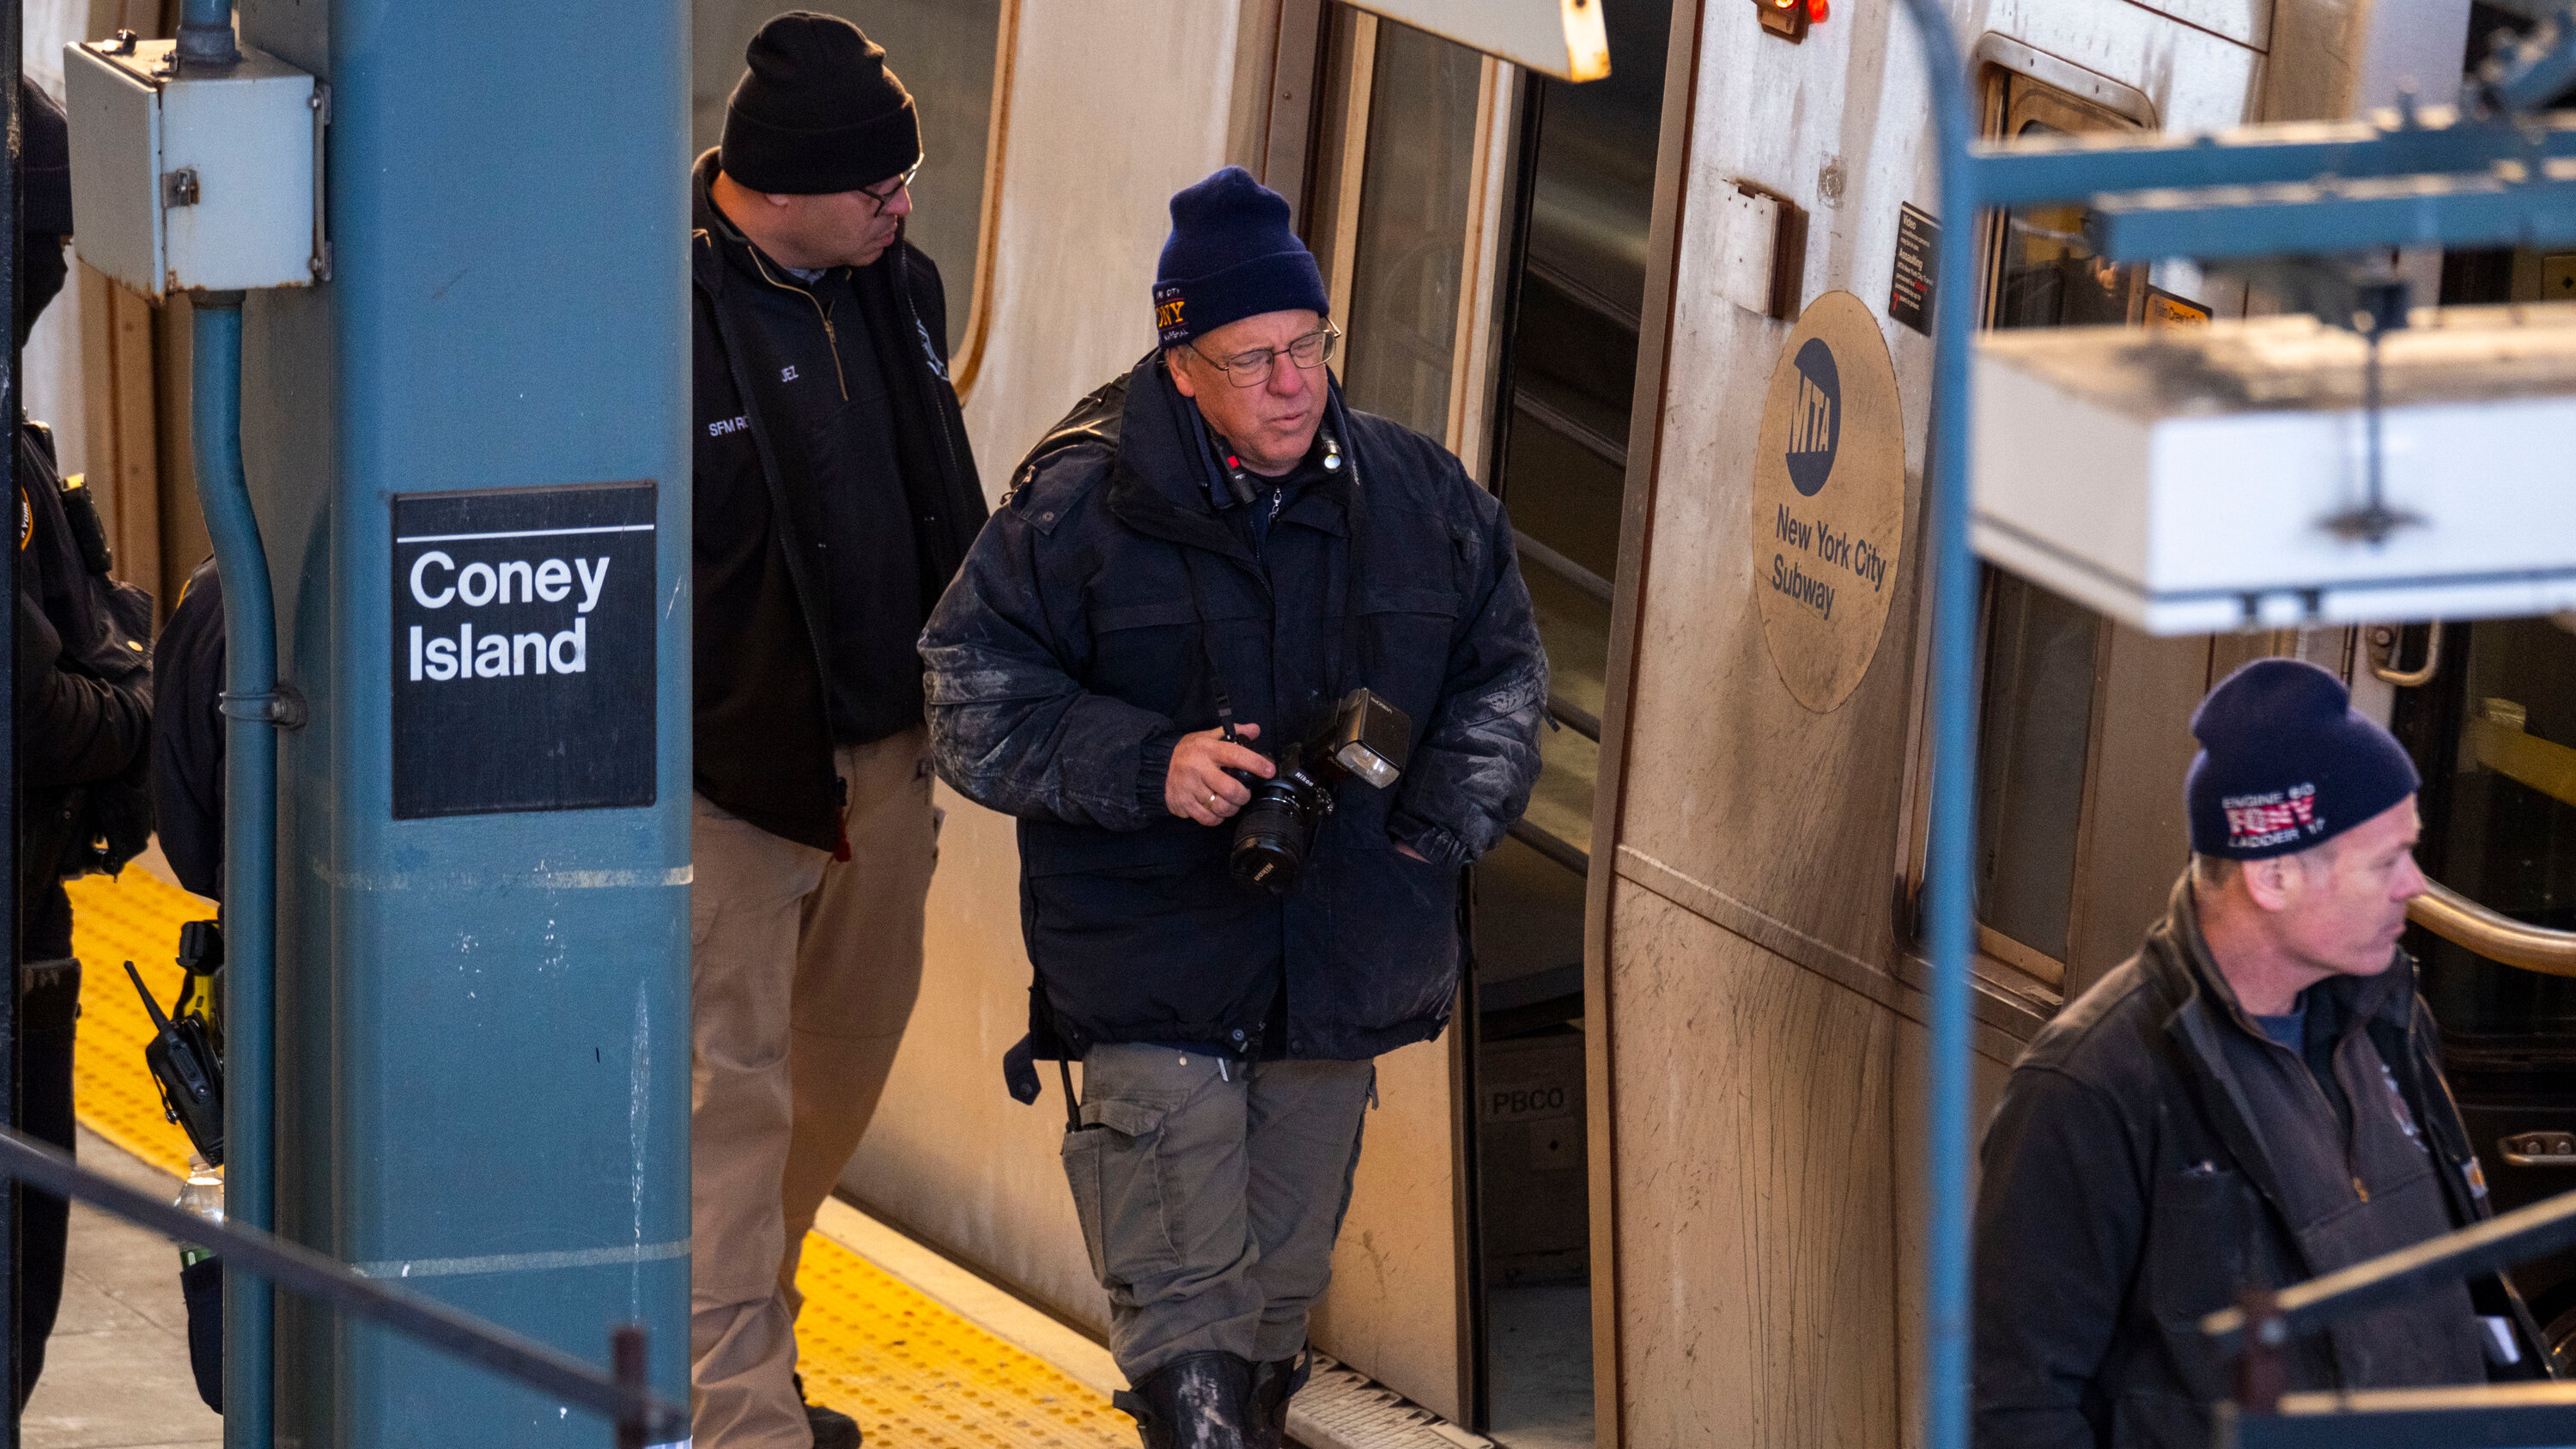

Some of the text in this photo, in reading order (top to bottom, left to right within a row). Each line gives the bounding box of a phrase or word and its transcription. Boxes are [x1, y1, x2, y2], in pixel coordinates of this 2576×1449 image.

[1902, 214, 1917, 230] Video
[1899, 247, 1923, 271] Assaulting
[1893, 292, 1900, 310] 7
[1156, 301, 1184, 327] DNY
[1789, 365, 1831, 454] MTA
[708, 418, 736, 437] SFM
[1776, 502, 1886, 593] New York City
[410, 550, 611, 613] Coney
[1772, 552, 1836, 621] Subway
[410, 617, 586, 681] Island
[1295, 771, 1314, 787] Nikon
[2221, 792, 2286, 808] ENGINE
[2227, 827, 2300, 848] LADDER
[1254, 862, 1274, 881] Nikon
[1493, 1087, 1564, 1114] PBCO
